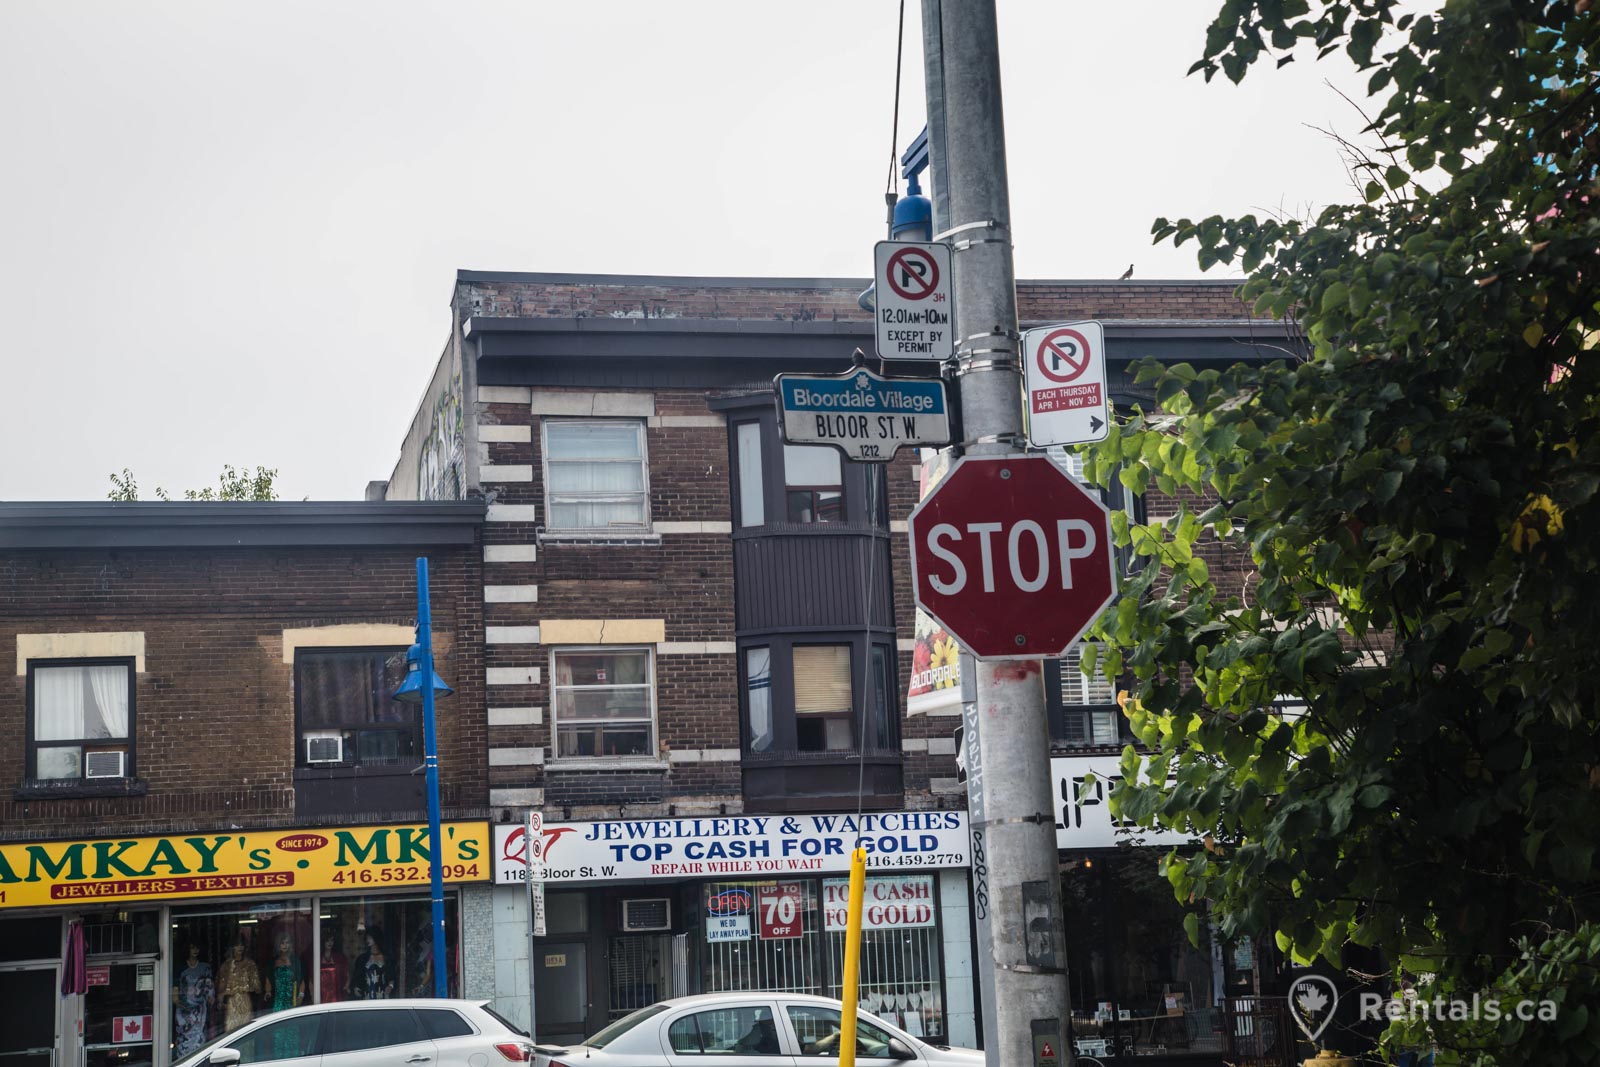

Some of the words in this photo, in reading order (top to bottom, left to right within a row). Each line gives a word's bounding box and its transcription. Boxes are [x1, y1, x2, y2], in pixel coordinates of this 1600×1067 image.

[933, 293, 945, 302] 3H
[882, 308, 948, 324] 12:01AM-10AM
[888, 330, 924, 341] EXCEPT
[930, 331, 942, 342] BY
[898, 342, 933, 352] PERMIT
[1037, 390, 1056, 400] EACH
[1059, 385, 1096, 397] THURSDAY
[793, 388, 876, 407] Bloordale
[878, 391, 934, 412] Village
[1038, 401, 1053, 410] APR
[1056, 400, 1059, 408] 1
[1069, 397, 1084, 406] NOV
[1088, 396, 1098, 404] 30
[815, 415, 870, 438] BLOOR
[878, 416, 899, 439] ST.
[903, 416, 920, 440] W.
[860, 445, 879, 457] 1212
[927, 518, 1096, 596] STOP
[585, 817, 771, 841] JEWELLERY
[780, 816, 802, 834] &
[811, 812, 960, 833] WATCHES
[281, 839, 302, 848] SINCE
[304, 837, 322, 847] 1974
[609, 843, 673, 862] TOP
[684, 840, 770, 860] CASH
[782, 838, 845, 857] FOR
[855, 834, 939, 854] GOLD
[651, 862, 704, 874] REPAIR
[707, 861, 752, 873] WHILE
[756, 860, 784, 871] YOU
[788, 858, 824, 870] WAIT
[865, 853, 963, 867] 416.459.2779
[580, 866, 597, 878] St.
[601, 866, 618, 876] W.
[56, 880, 176, 897] JEWELLERS
[192, 874, 288, 890] TEXTILES
[761, 886, 778, 894] UP
[825, 884, 866, 902] TO
[707, 896, 751, 911] OPEN
[868, 904, 931, 925] GOLD
[720, 920, 728, 928] WE
[772, 927, 791, 935] OFF
[720, 930, 734, 938] AWAY
